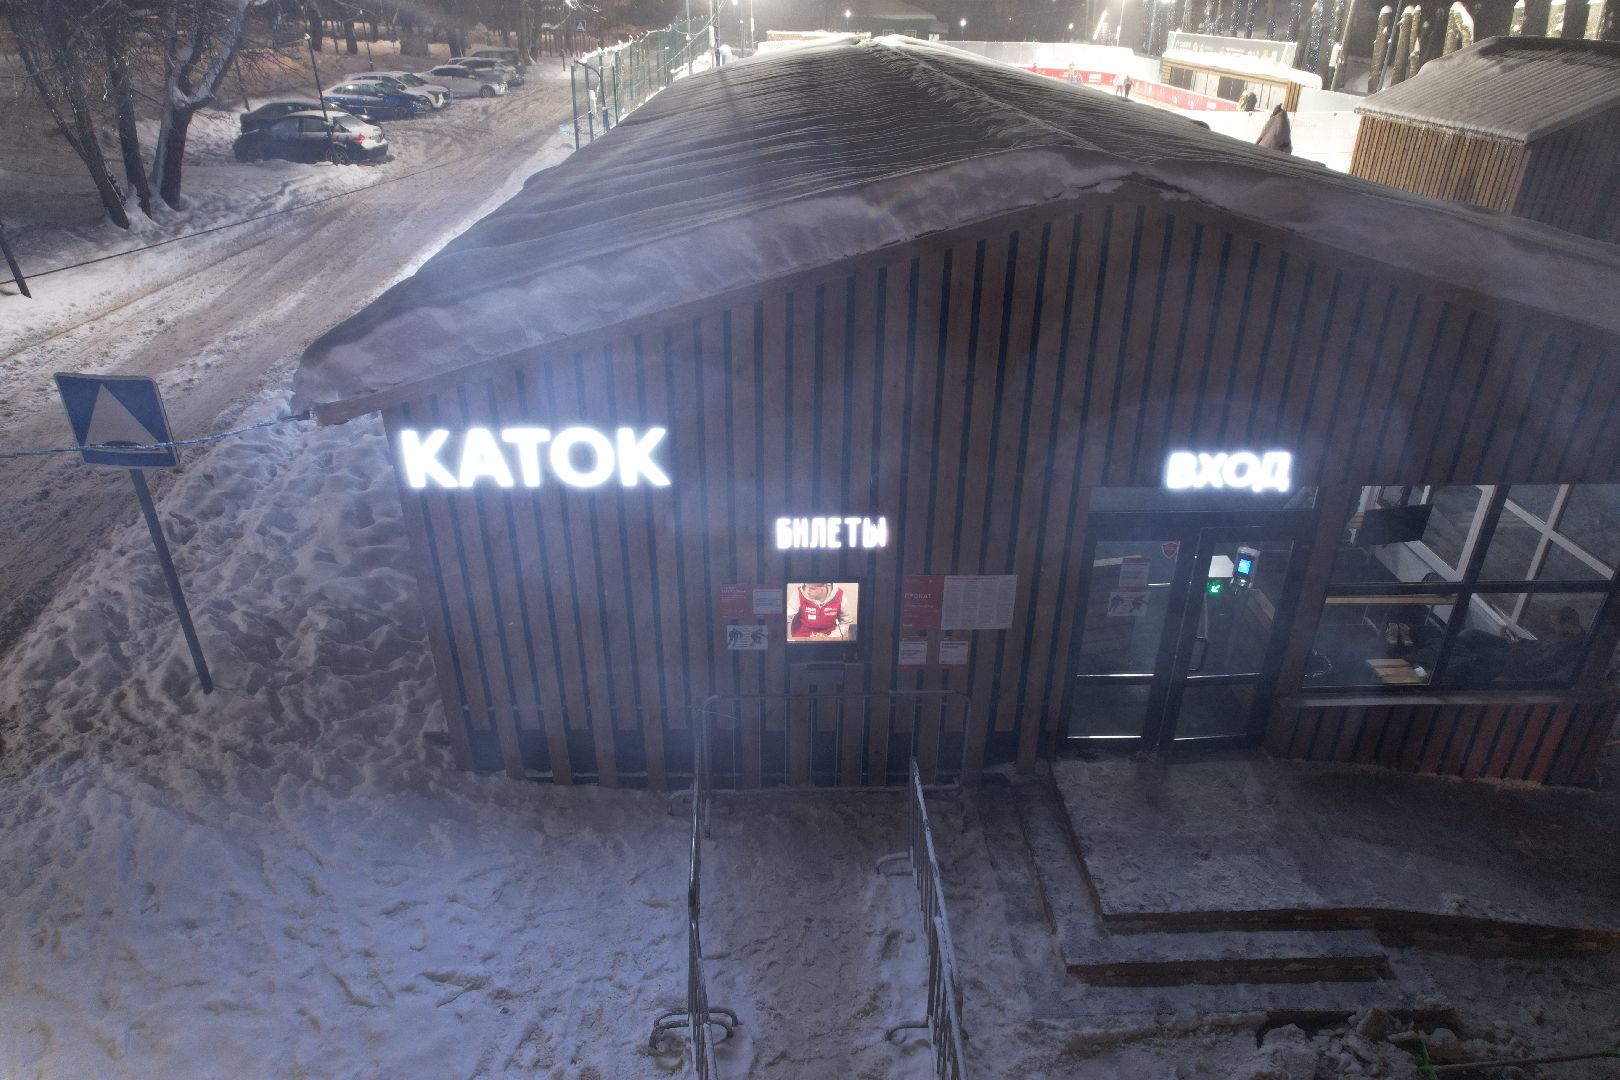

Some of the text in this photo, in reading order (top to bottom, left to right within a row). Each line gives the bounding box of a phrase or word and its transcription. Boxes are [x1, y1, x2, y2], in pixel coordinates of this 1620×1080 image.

[399, 425, 671, 488] КАТОК
[1165, 451, 1292, 493] ВХОД
[775, 516, 888, 549] БИЛЕТЫ
